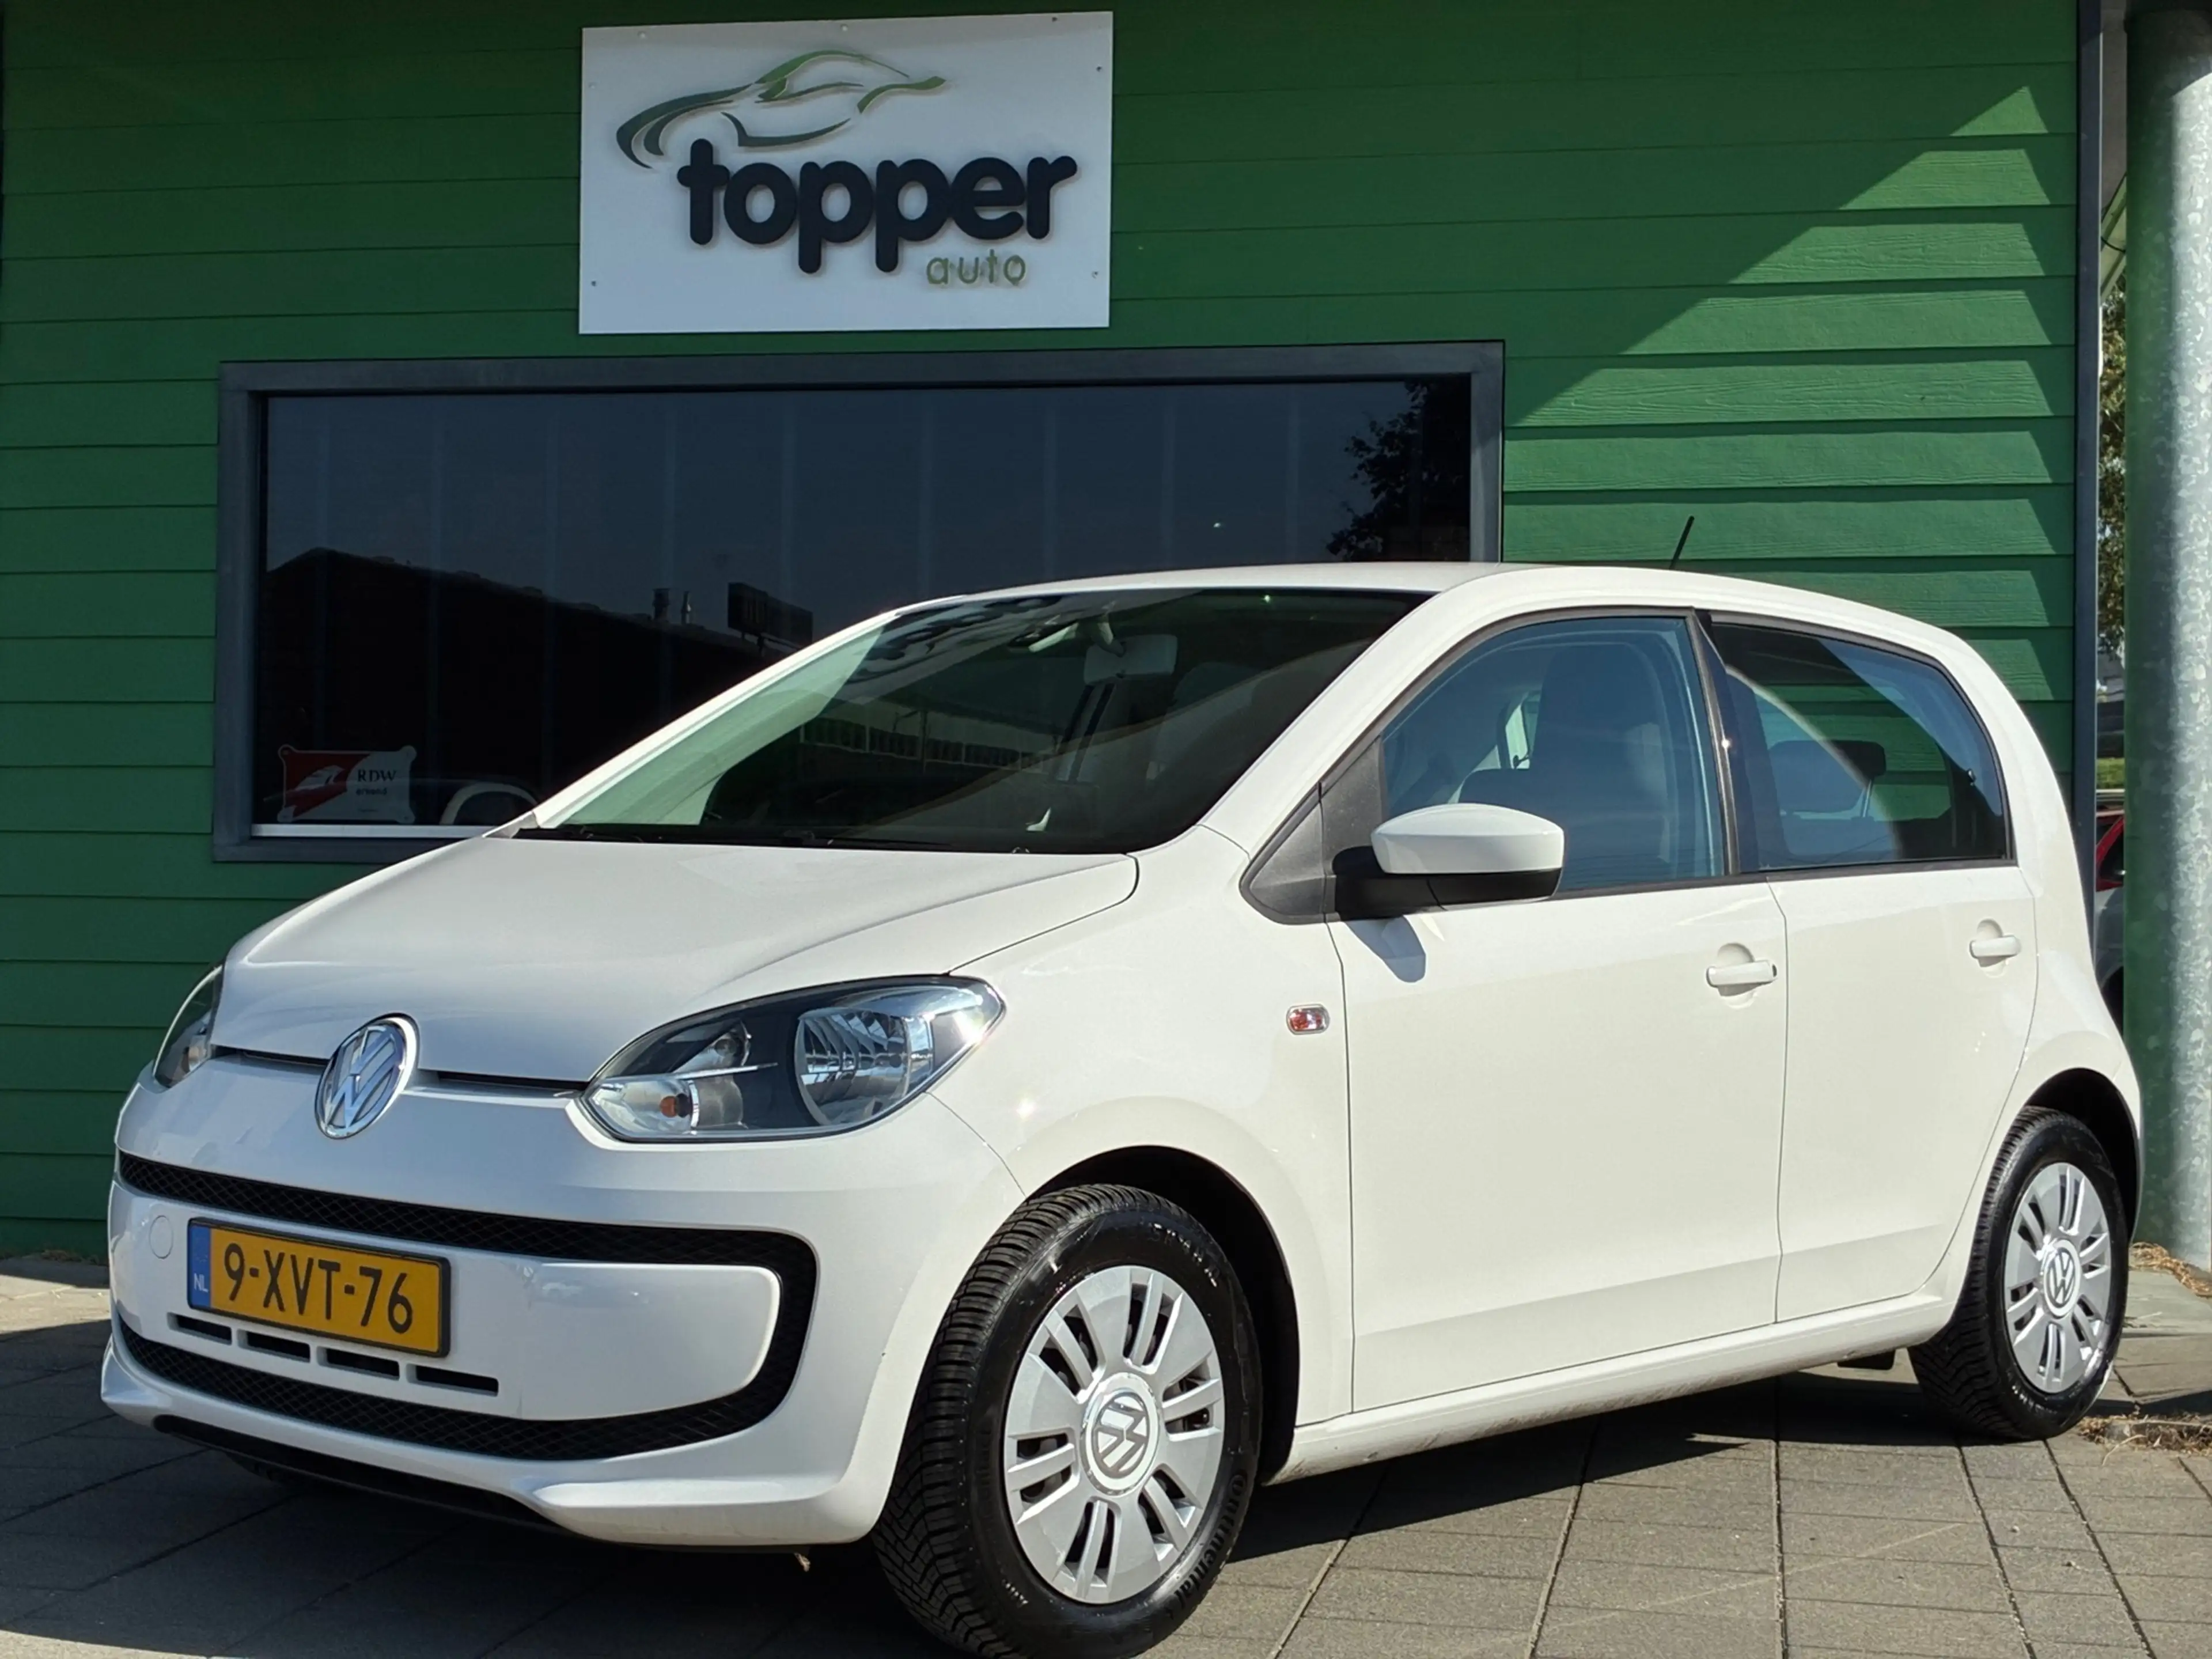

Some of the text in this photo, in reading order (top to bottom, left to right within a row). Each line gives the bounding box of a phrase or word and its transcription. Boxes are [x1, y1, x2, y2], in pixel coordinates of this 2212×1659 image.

[676, 138, 1078, 274] topper
[926, 249, 1027, 286] auto
[358, 768, 397, 782] RDW
[194, 1243, 413, 1334] NL 9-XVT-76
